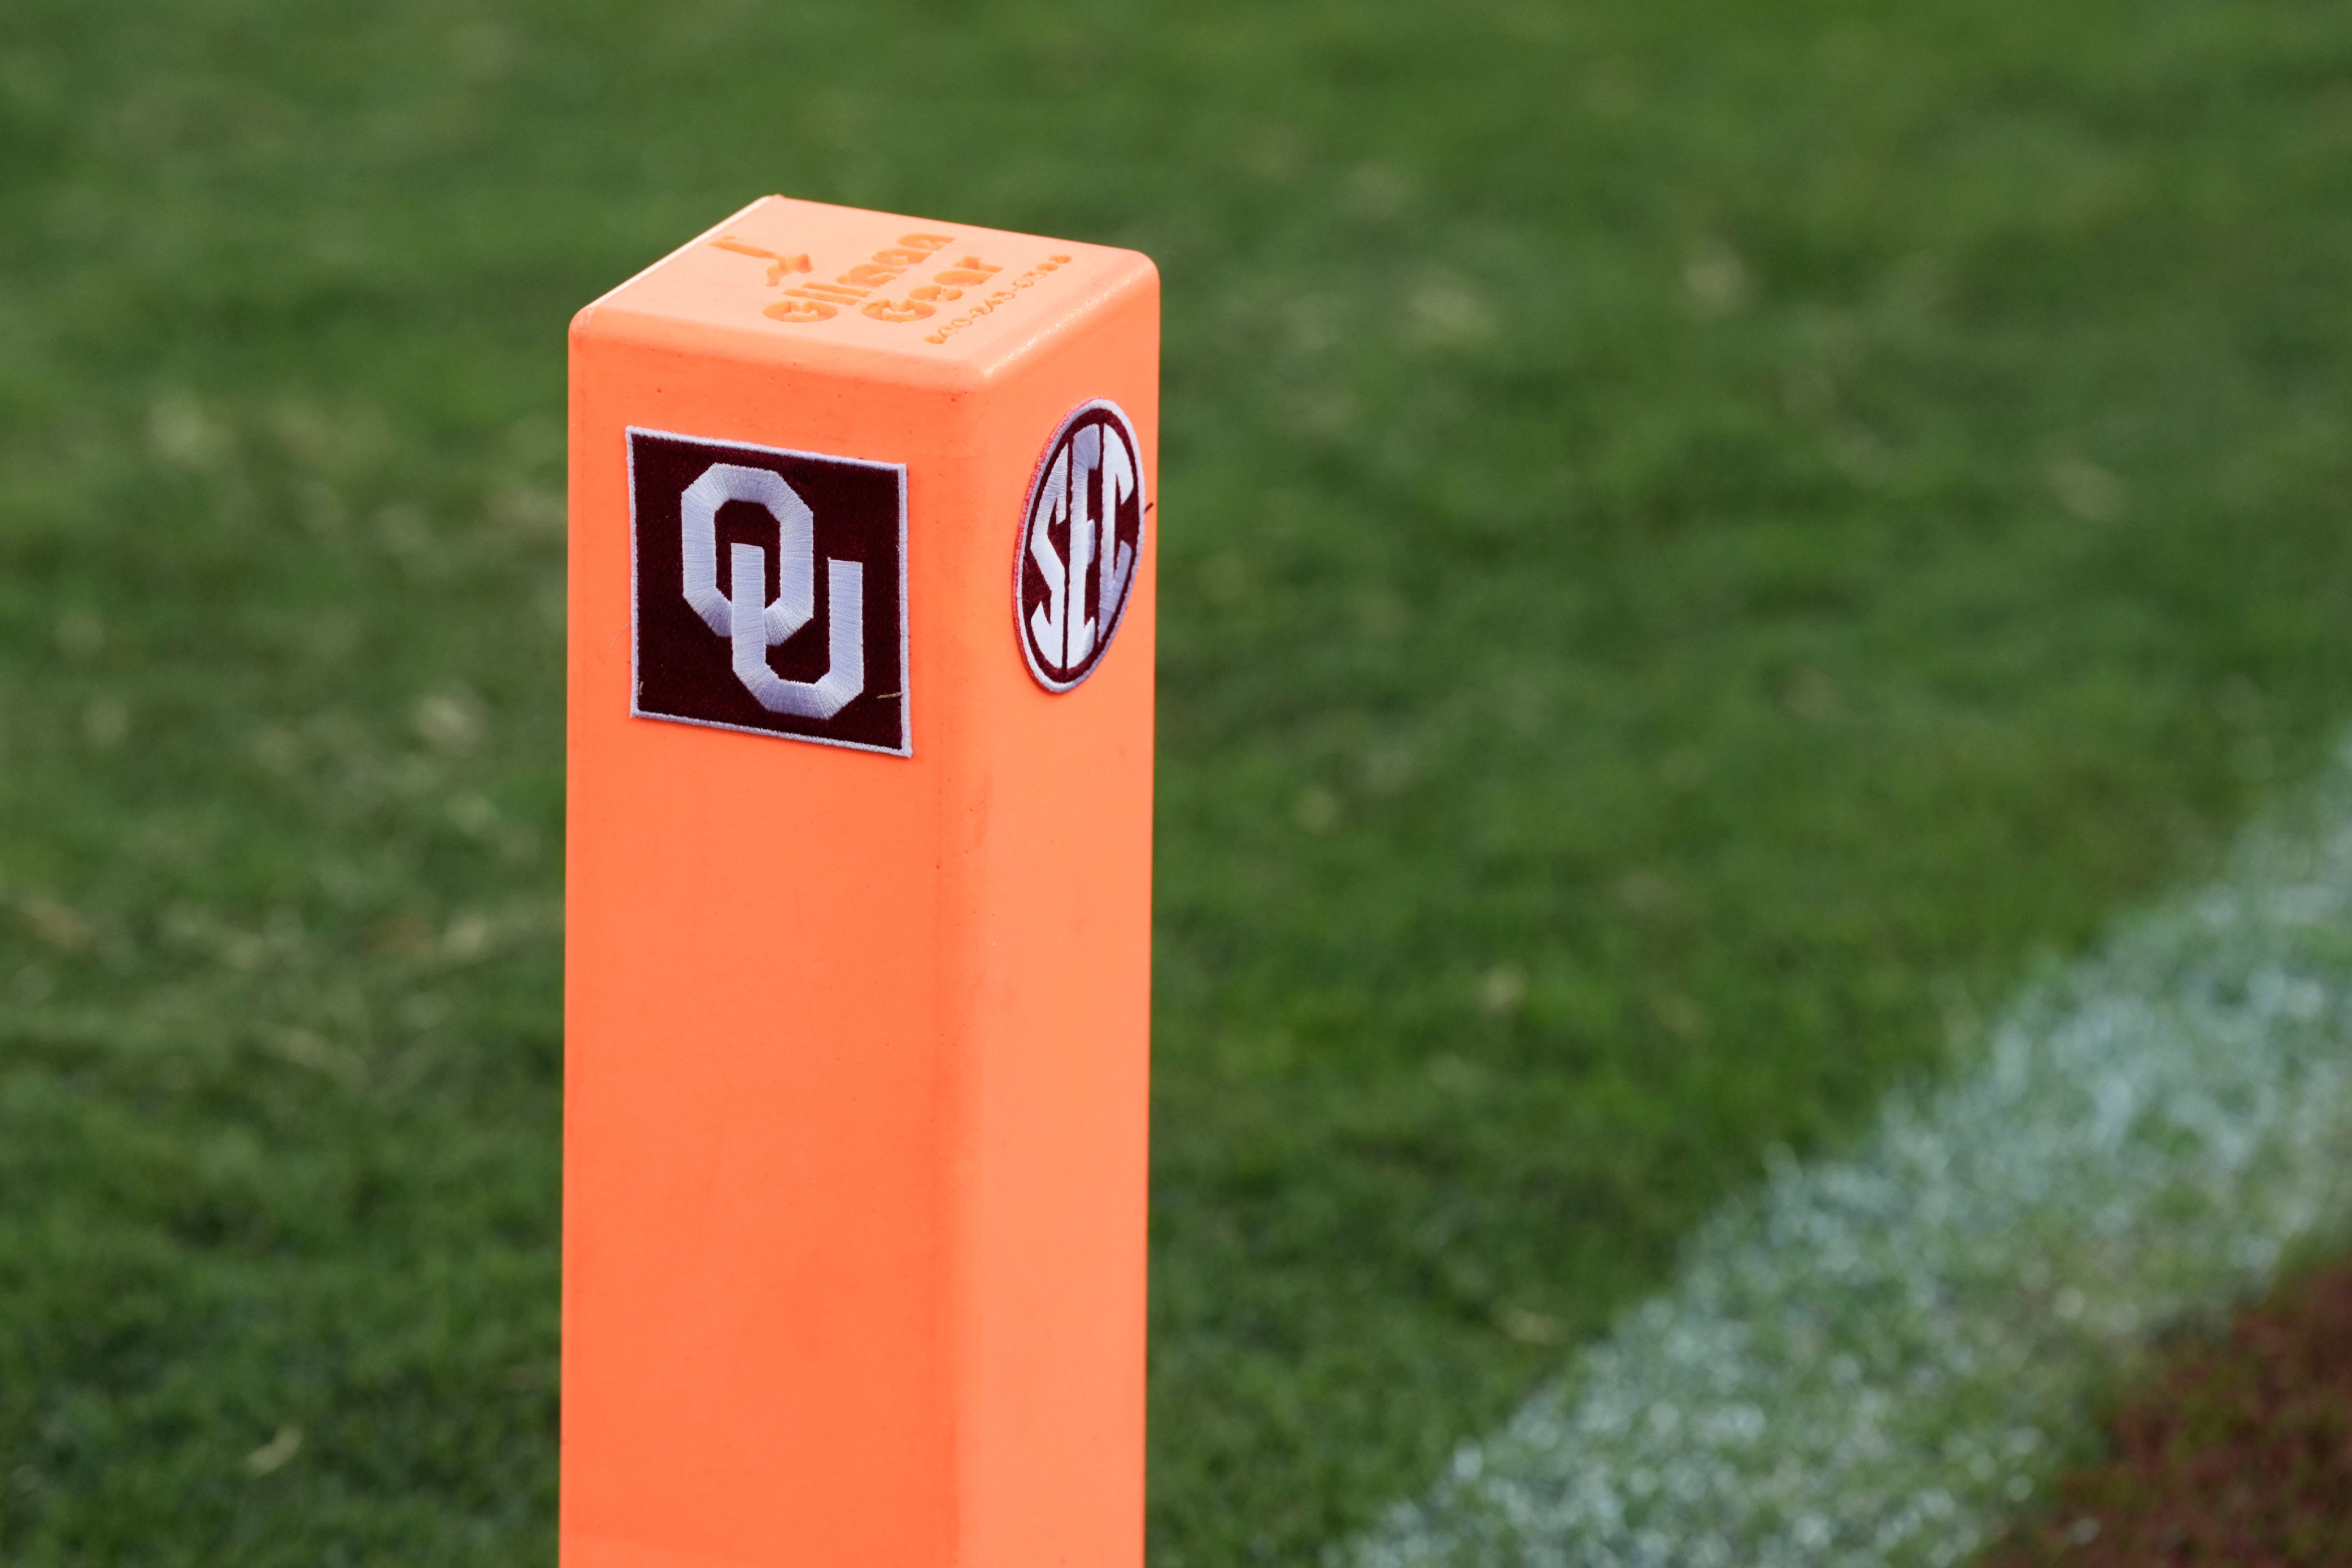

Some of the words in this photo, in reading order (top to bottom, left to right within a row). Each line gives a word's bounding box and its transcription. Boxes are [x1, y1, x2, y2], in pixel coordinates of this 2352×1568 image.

[763, 233, 956, 323] Gilman
[860, 256, 1004, 323] Gear
[681, 462, 864, 720] OU
[1030, 423, 1134, 669] SEC
